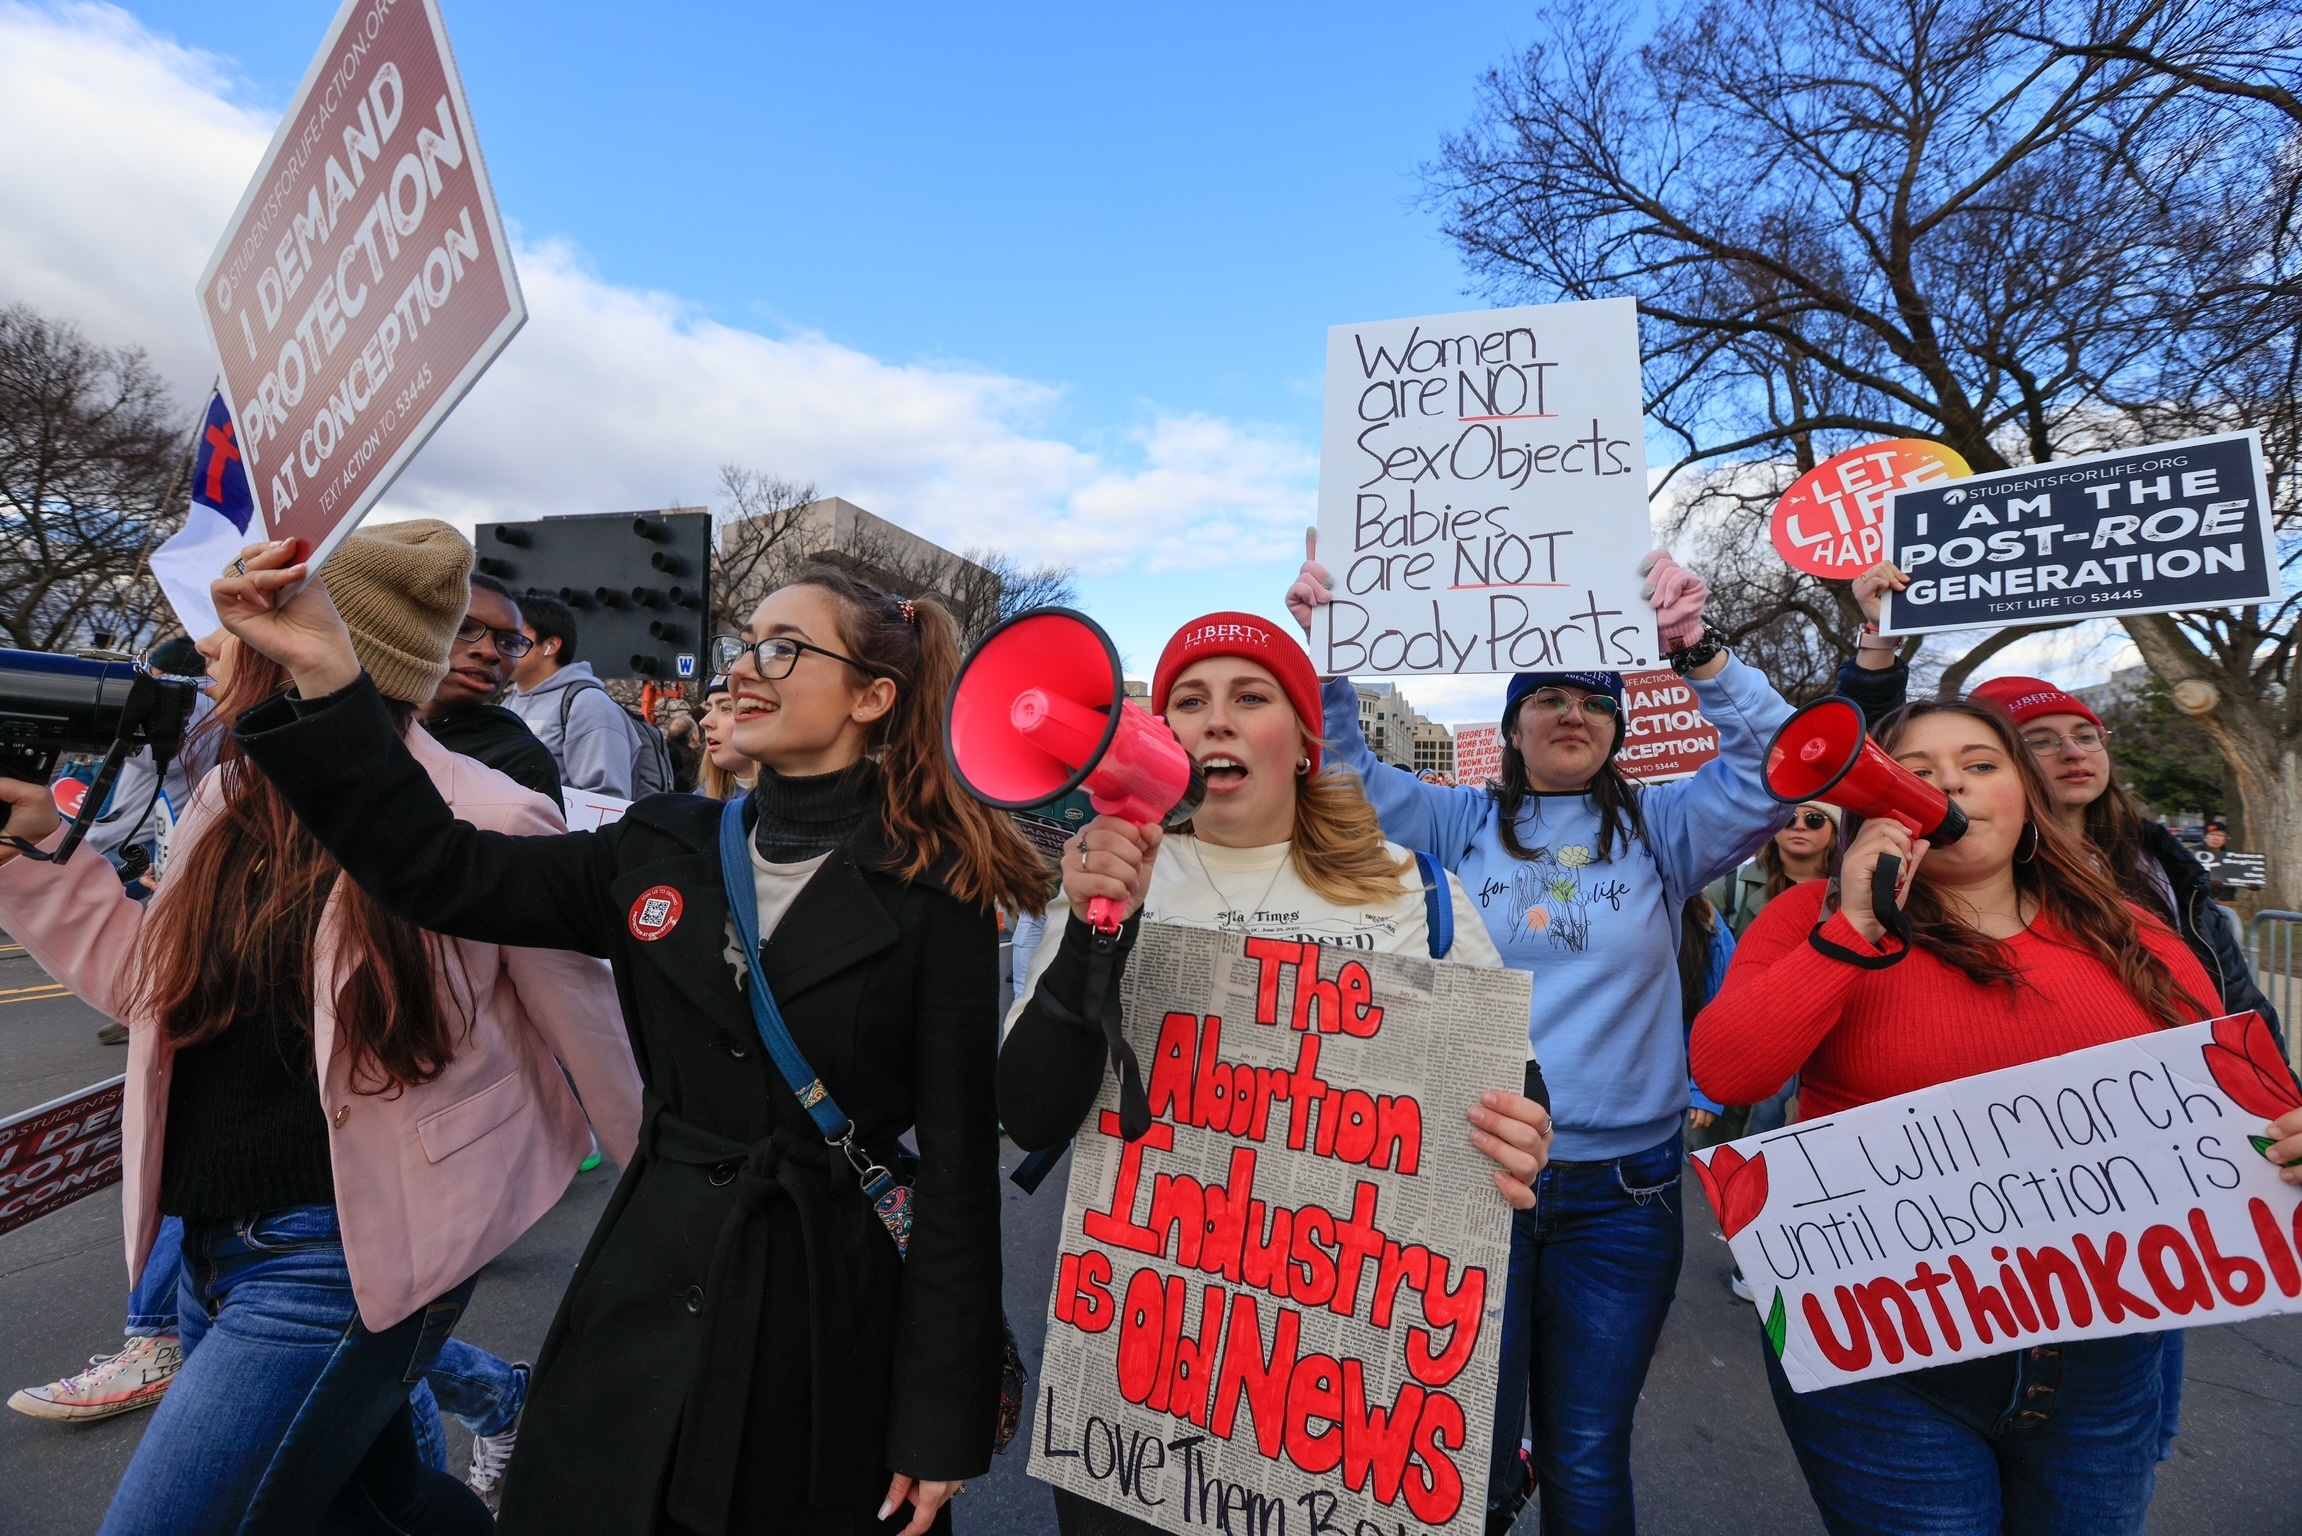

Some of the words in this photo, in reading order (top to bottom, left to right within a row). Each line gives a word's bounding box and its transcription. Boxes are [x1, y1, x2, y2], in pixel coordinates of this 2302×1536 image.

[227, 0, 396, 289] STUDENTSFORLIFEACTION.OR
[238, 307, 258, 361] I
[256, 61, 404, 334] DEMAND
[241, 95, 463, 465] PROTECTION
[271, 450, 299, 525] AT
[301, 206, 481, 478] CONCEPTION
[1355, 326, 1537, 379] Women
[1358, 377, 1448, 422] are
[1458, 361, 1559, 418] NOT
[319, 475, 344, 516] TEXT
[343, 429, 382, 489] ACTION
[380, 407, 396, 438] TO
[395, 364, 433, 420] 53445
[1811, 450, 1898, 505] LET
[1916, 512, 1928, 536] I
[1957, 493, 2052, 530] AM
[2084, 468, 2220, 510] THE
[1968, 455, 2188, 499] STUDENTSFORLIFE.ORG
[1355, 488, 1510, 552] Babies
[1812, 523, 1884, 568] HAP
[1900, 498, 2250, 574] POST-ROE
[1346, 552, 1434, 595] are
[1453, 531, 1574, 586] NOT
[1905, 543, 2246, 605] GENERATION
[1327, 598, 1479, 674] Body
[1486, 590, 1647, 671] Parts.
[1988, 600, 2023, 613] TEXT
[2027, 597, 2060, 609] LIFE
[2064, 595, 2086, 606] TO
[2090, 589, 2143, 602] 53445
[1185, 624, 1271, 644] LIBERTY
[1565, 673, 1596, 686] AMERICA
[1457, 729, 1483, 740] BEFORE
[1484, 727, 1497, 736] THE
[1457, 740, 1477, 750] WOMB
[1479, 738, 1493, 746] YOU
[1457, 749, 1475, 759] WERE
[1458, 769, 1473, 777] AND
[1655, 761, 1679, 770] 53445
[666, 890, 678, 906] DEMAND
[1254, 910, 1300, 925] Times
[1479, 877, 1510, 908] for
[1594, 879, 1630, 911] life
[1245, 937, 1384, 1038] The
[1149, 1011, 1422, 1177] Abortion
[1761, 1122, 1866, 1207] I
[1858, 1108, 1981, 1187] will
[1988, 1062, 2223, 1160] march
[1755, 1204, 1887, 1281] until
[1894, 1153, 2159, 1253] abortion
[2172, 1136, 2241, 1198] is
[1083, 1109, 1488, 1388] Industry
[1801, 1196, 2302, 1373] unthinkabl
[154, 1345, 183, 1365] PR
[1116, 1267, 1225, 1427] Old
[1210, 1293, 1468, 1526] News
